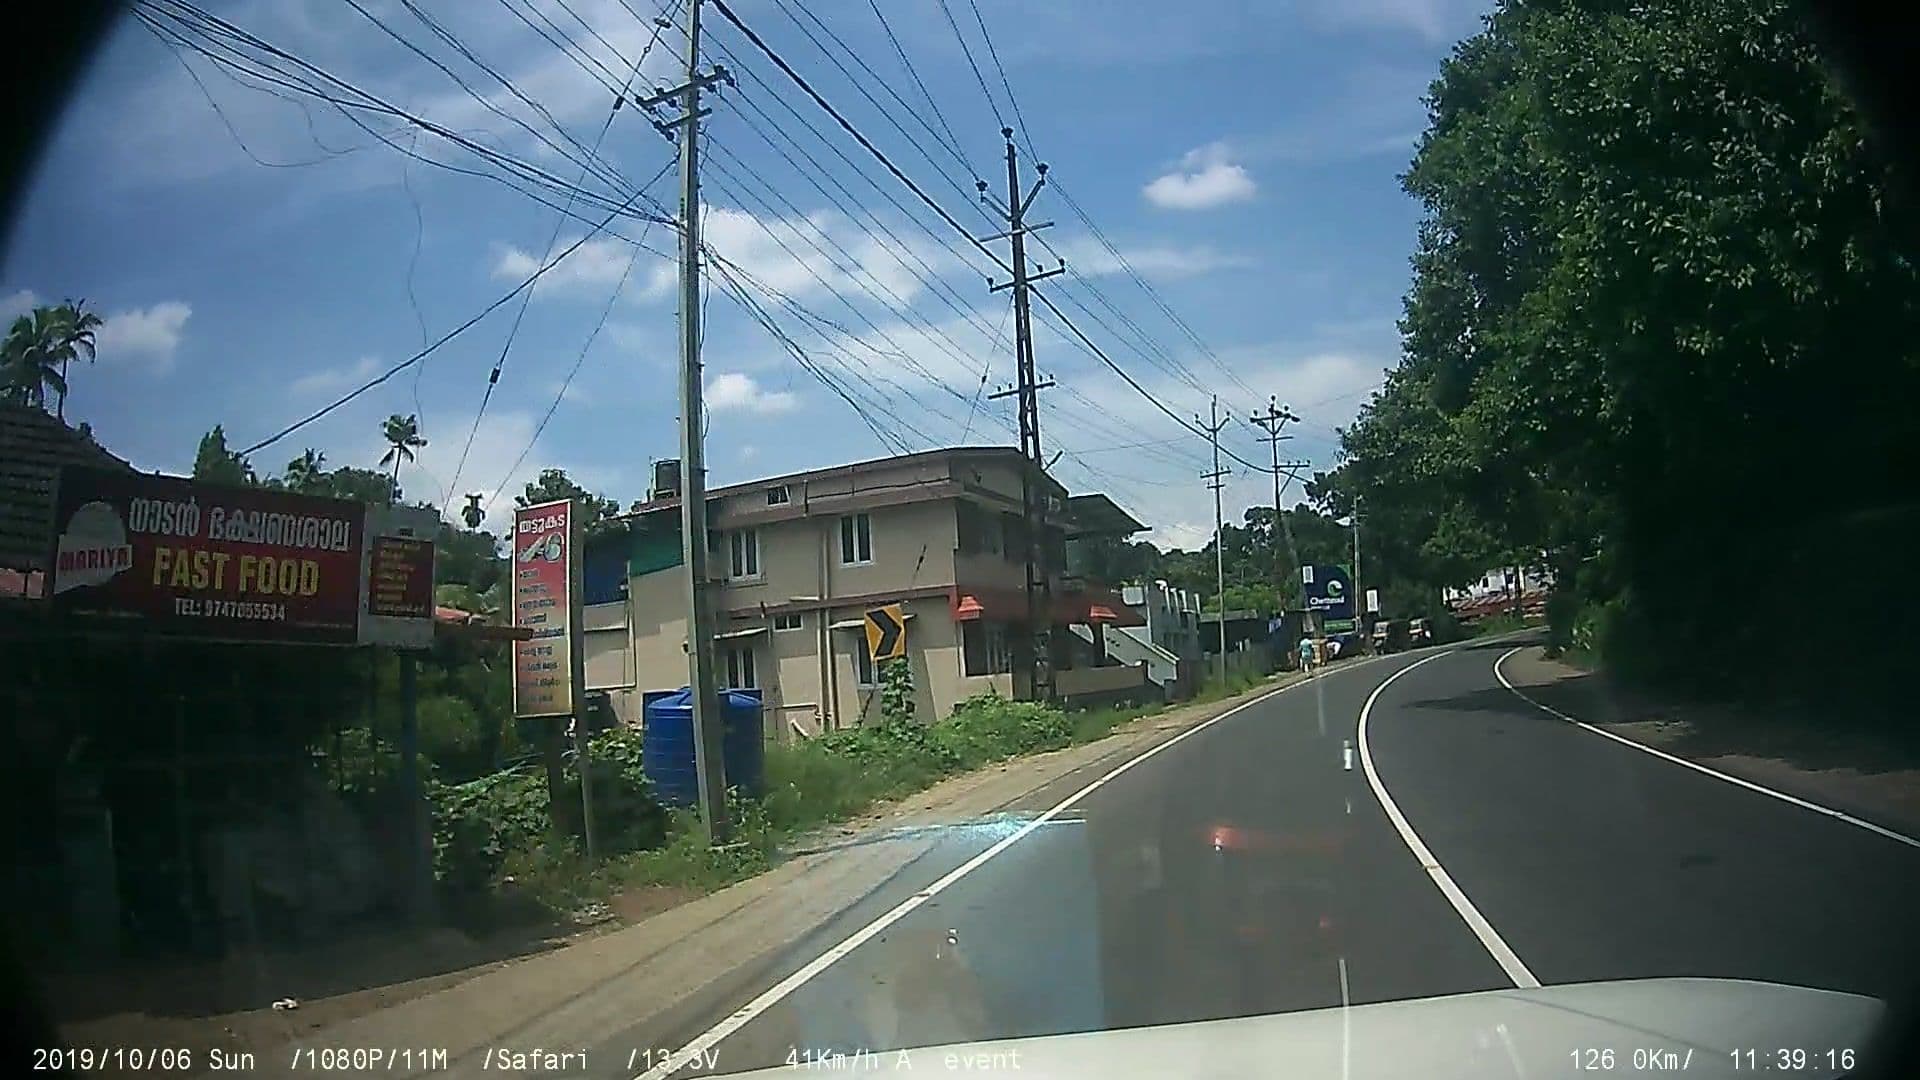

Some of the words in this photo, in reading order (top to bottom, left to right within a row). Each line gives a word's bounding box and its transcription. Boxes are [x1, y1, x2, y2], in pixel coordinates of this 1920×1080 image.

[153, 547, 230, 589] FAST
[239, 554, 320, 597] FOOD
[176, 597, 201, 616] TEL:
